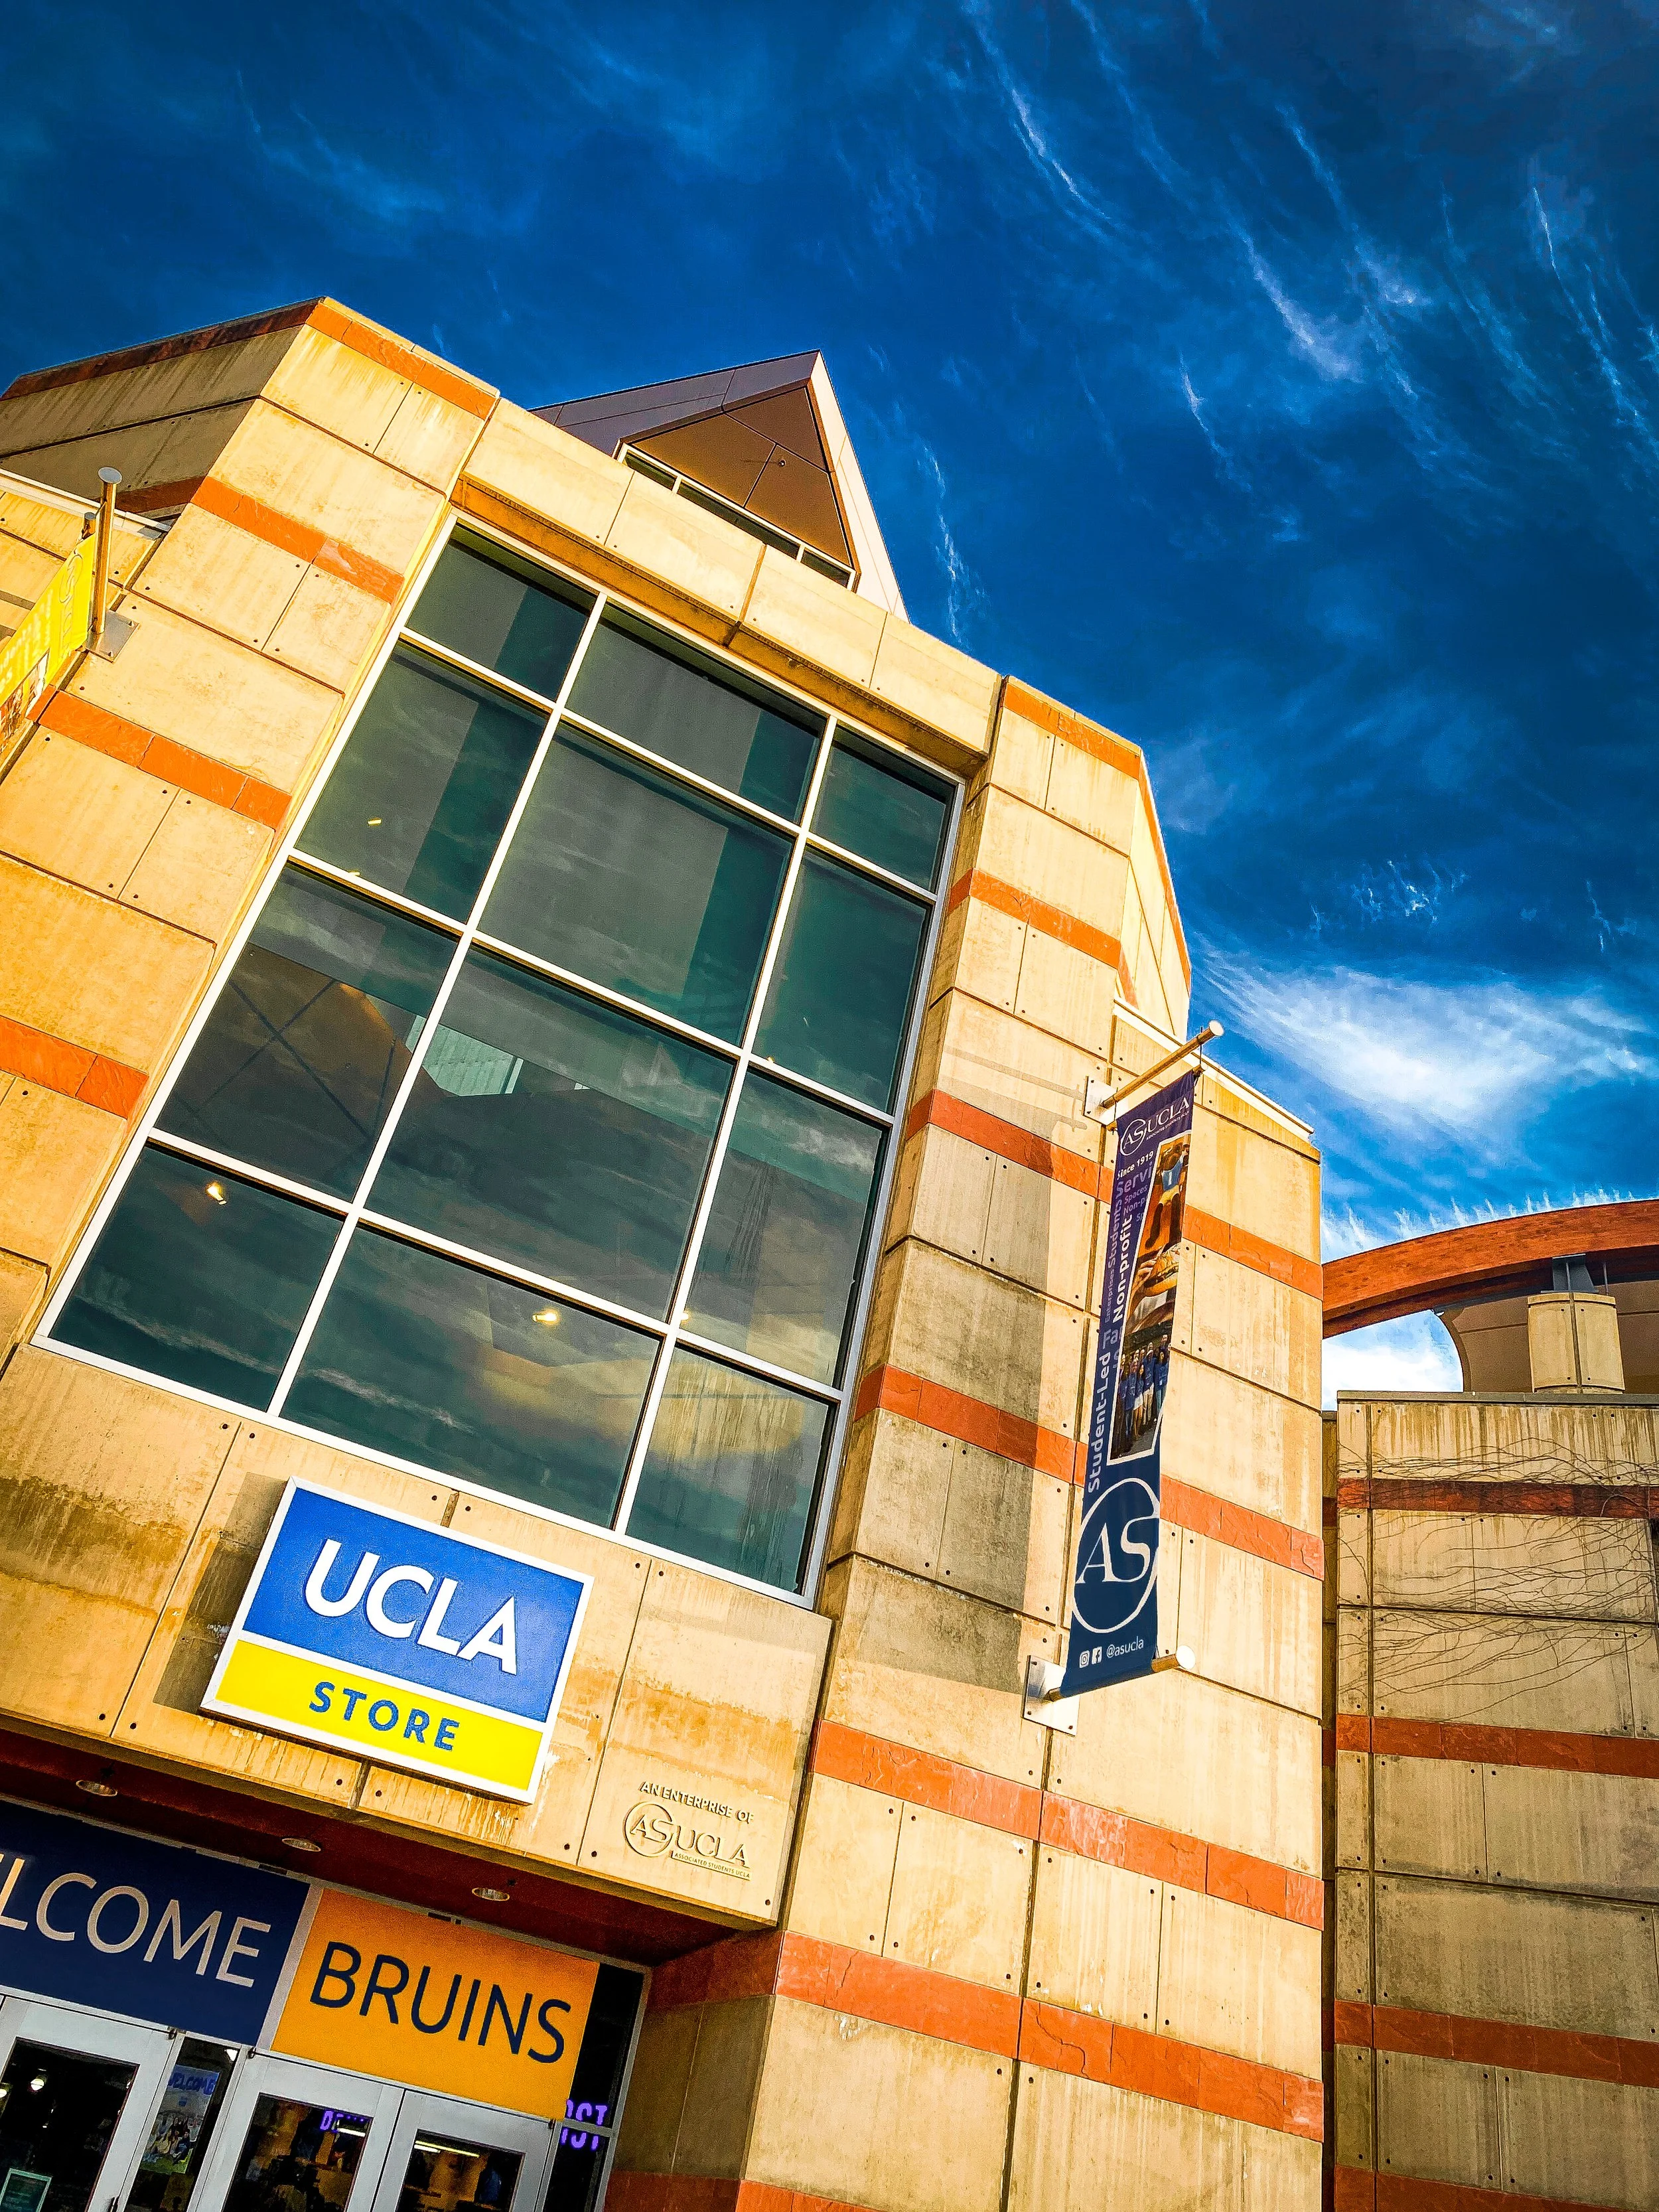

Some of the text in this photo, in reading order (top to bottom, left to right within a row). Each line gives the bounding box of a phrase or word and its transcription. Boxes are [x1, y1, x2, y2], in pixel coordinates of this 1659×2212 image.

[1116, 1150, 1154, 1181] Since 1919
[1123, 1197, 1147, 1217] Non-p
[1124, 1185, 1148, 1205] Spaces
[1108, 1199, 1123, 1269] Students
[1104, 1269, 1115, 1323] Enterprises
[1112, 1214, 1133, 1324] Non-profit
[1088, 1351, 1112, 1494] Student-Led
[305, 1538, 518, 1676] UCLA
[1106, 1635, 1144, 1659] @asucla
[309, 1680, 461, 1752] STORE
[639, 1781, 754, 1824] AN ENTERPRISE OF
[674, 1852, 751, 1879] ASSOCIATED STUDENTS UCLA
[0, 1854, 572, 2064] LCOME BRUINS
